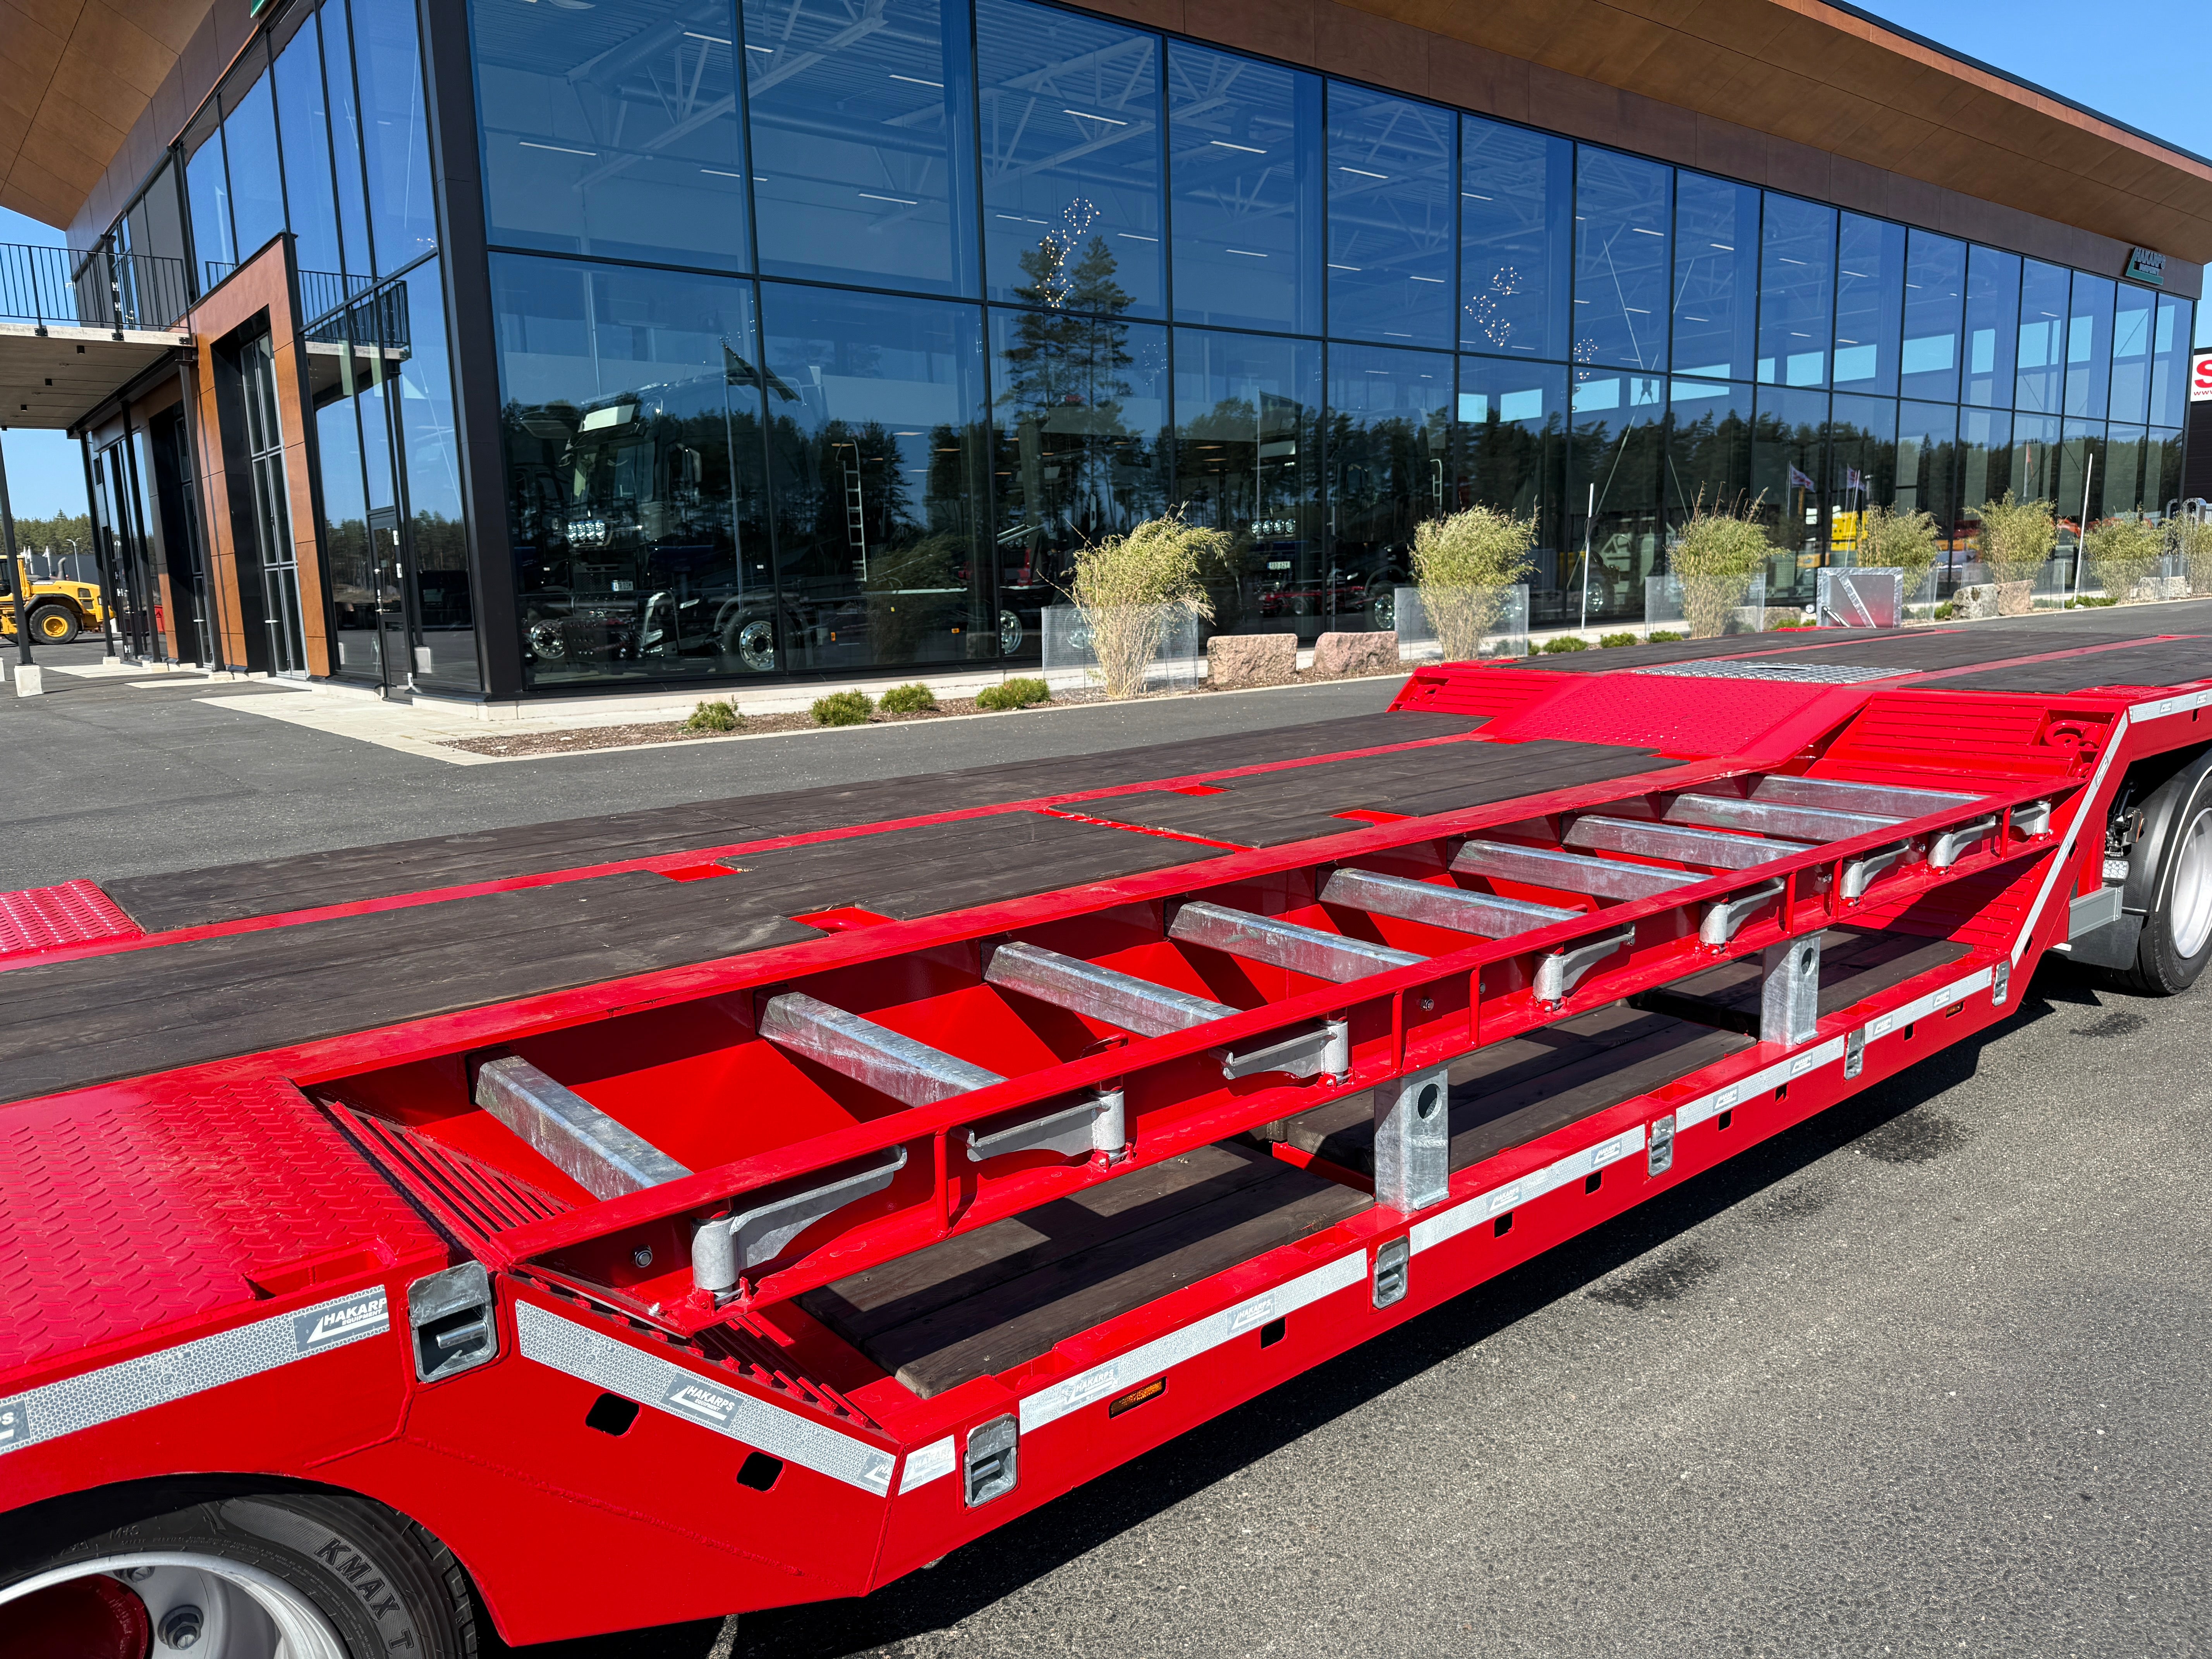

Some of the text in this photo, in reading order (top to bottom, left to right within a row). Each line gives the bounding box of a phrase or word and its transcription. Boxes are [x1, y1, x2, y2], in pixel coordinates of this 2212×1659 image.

[1495, 1187, 1519, 1202] HAKARPS
[324, 1297, 387, 1326] HAKARP
[342, 1309, 383, 1326] EQUIPMENT
[1239, 1298, 1273, 1320] HAKARPS
[1076, 1369, 1114, 1392] HAKARPS
[687, 1385, 735, 1412] HAKARPS
[694, 1399, 721, 1412] EQUIPMENT
[314, 1537, 400, 1620] KMAX
[388, 1628, 414, 1649] T
